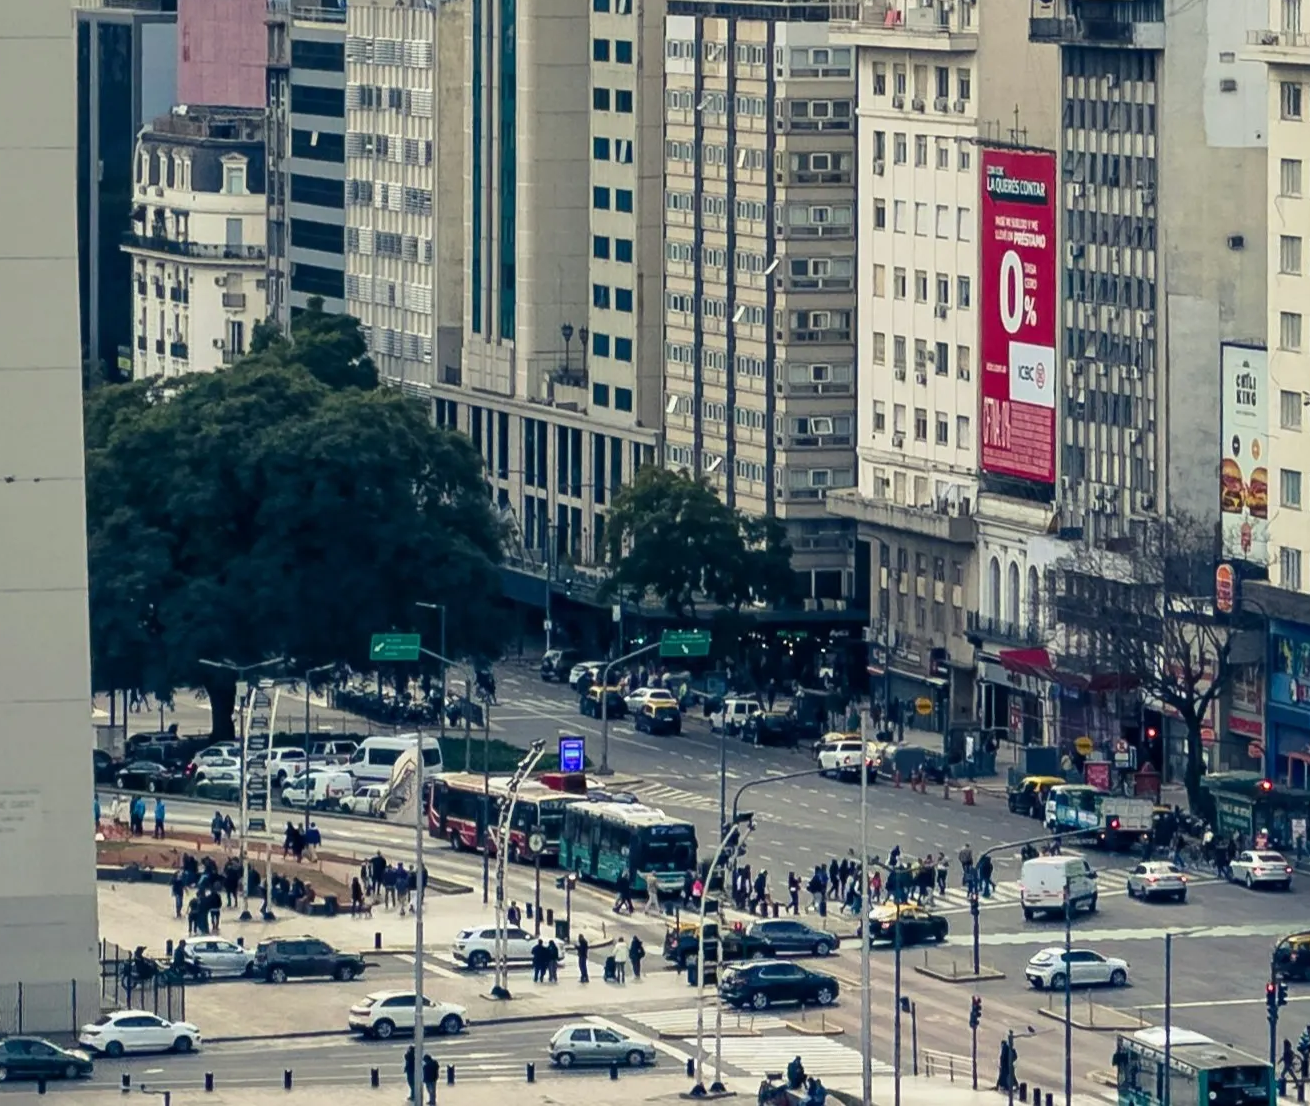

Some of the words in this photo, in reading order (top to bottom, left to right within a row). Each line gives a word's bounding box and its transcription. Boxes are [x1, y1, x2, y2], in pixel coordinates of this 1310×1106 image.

[986, 177, 995, 191] LA
[995, 176, 1020, 194] QUERÉS
[1020, 180, 1046, 197] CONTAR
[1000, 250, 1024, 334] 0
[1024, 295, 1037, 327] %
[1018, 364, 1035, 382] ICBC
[1236, 390, 1257, 407] KING
